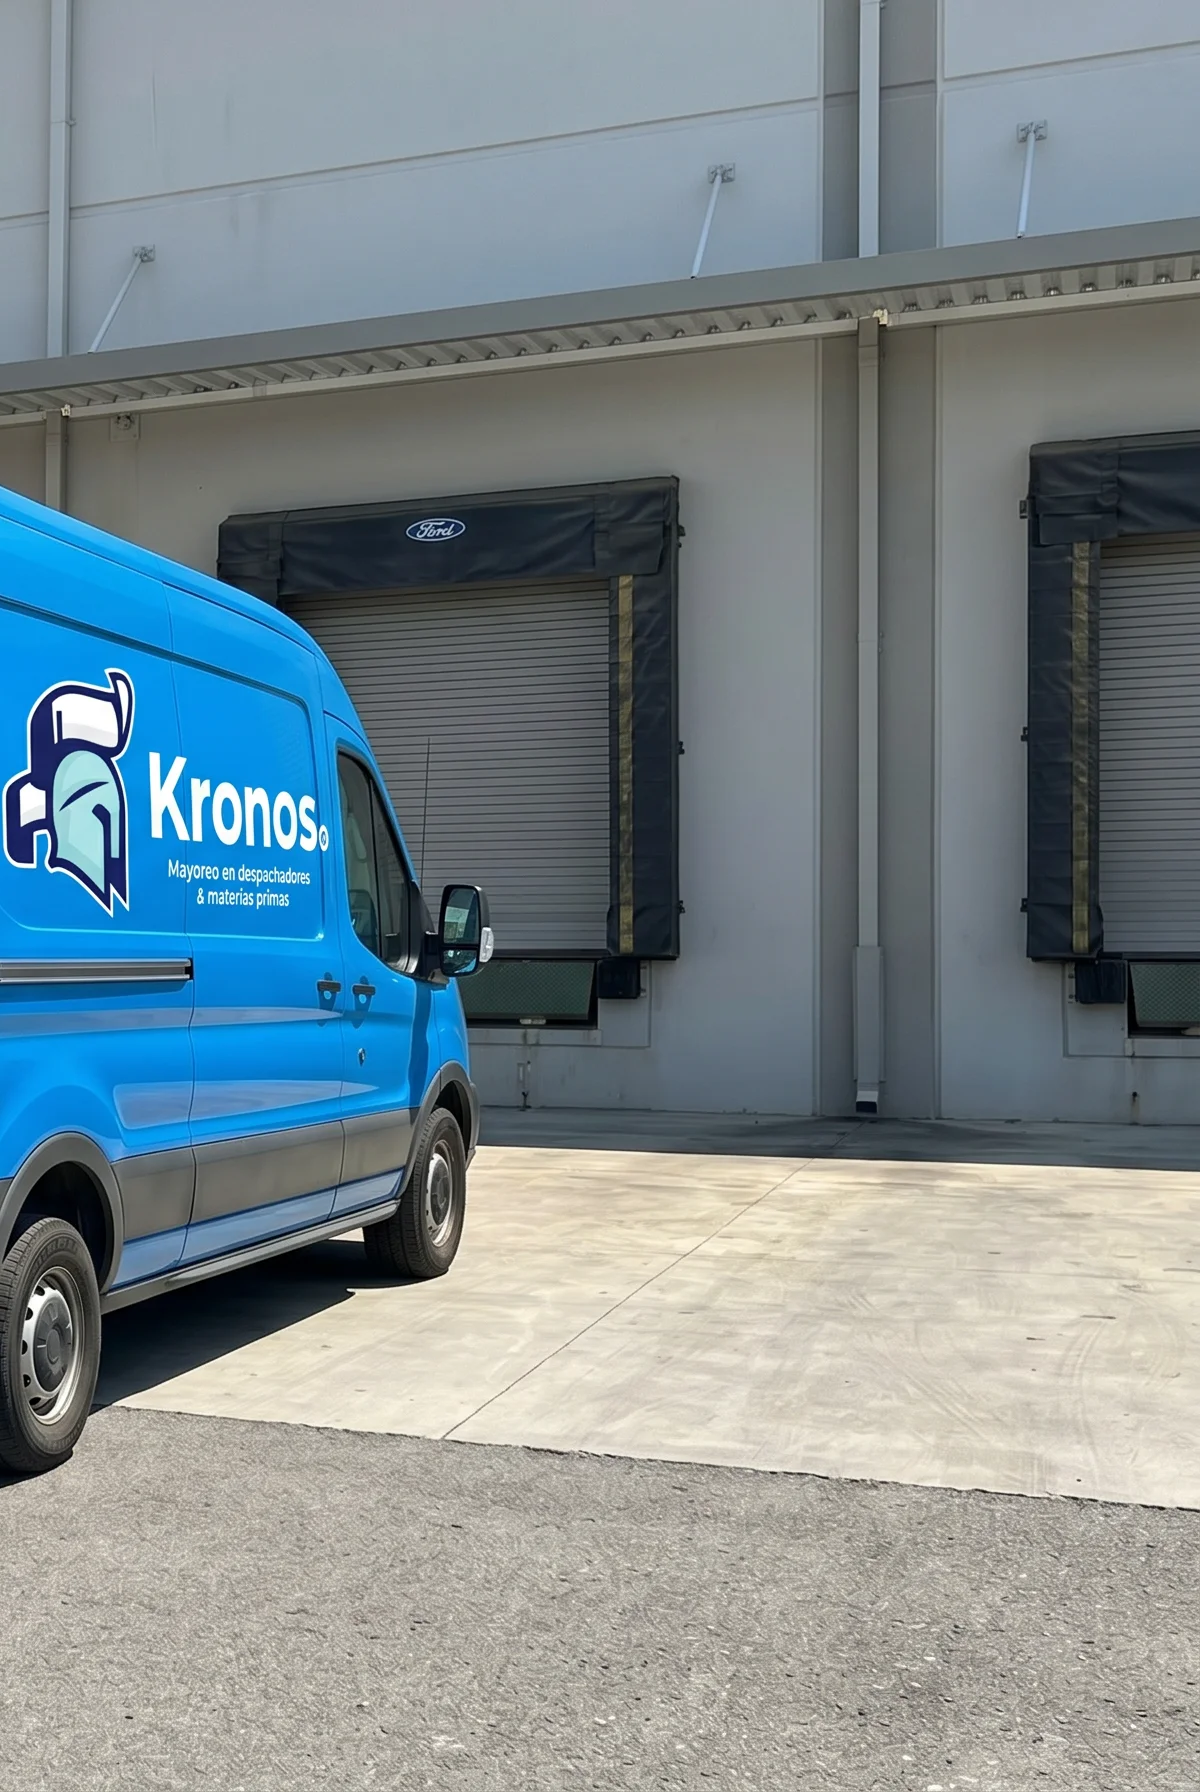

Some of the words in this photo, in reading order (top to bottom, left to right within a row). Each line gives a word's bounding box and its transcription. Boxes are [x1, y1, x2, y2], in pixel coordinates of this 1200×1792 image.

[415, 520, 456, 539] Ford
[148, 751, 319, 852] Kronos
[167, 858, 219, 883] Mayoreo
[222, 867, 235, 881] en
[238, 864, 311, 887] despachadores
[196, 887, 205, 905] &
[207, 888, 254, 906] materias
[256, 889, 290, 909] primas
